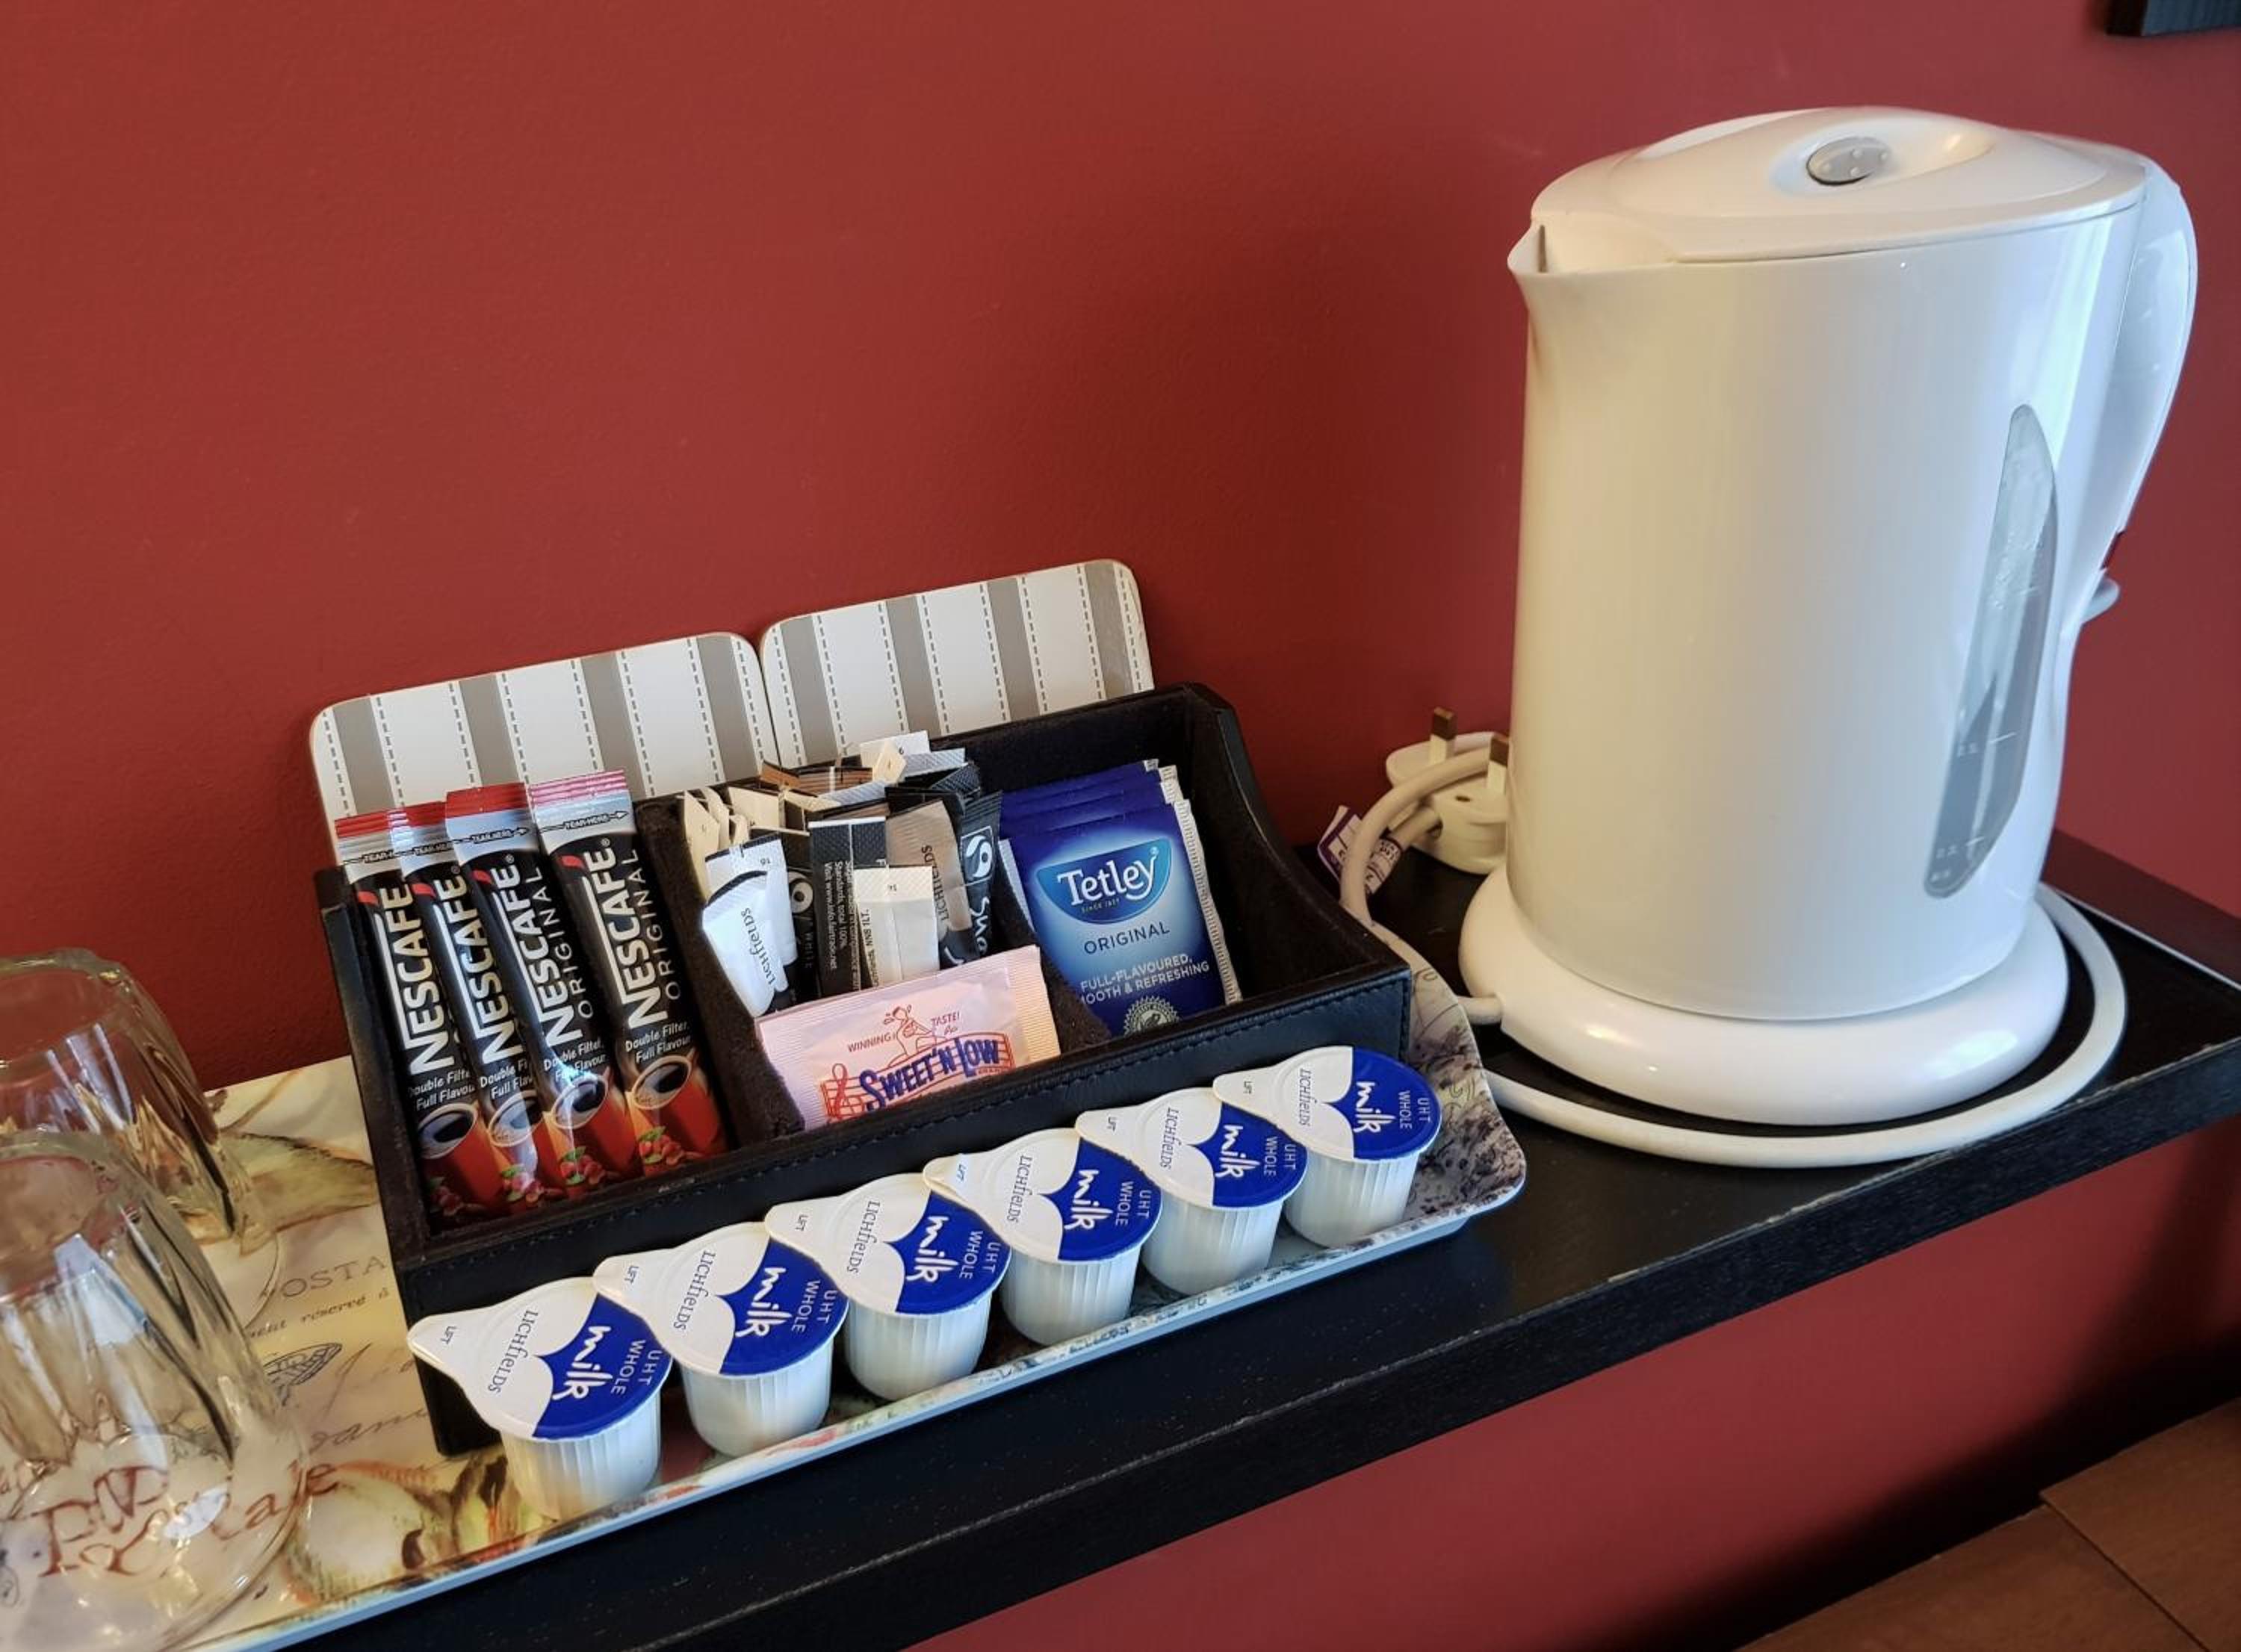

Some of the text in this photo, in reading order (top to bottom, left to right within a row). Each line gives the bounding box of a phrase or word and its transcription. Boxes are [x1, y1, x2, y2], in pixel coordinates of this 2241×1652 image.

[1057, 854, 1158, 906] Tetley
[622, 849, 681, 1000] ORIGINAL
[1084, 921, 1171, 955] ORIGINAL
[525, 867, 594, 1019] ORIGINAL
[1082, 984, 1121, 1004] OOTH
[1135, 960, 1210, 991] REFRESHING
[625, 1030, 660, 1052] Double
[636, 1035, 691, 1063] Full Flavour
[480, 1066, 516, 1088] Double
[491, 1081, 510, 1099] Full
[1243, 1081, 1253, 1095] LIFT
[416, 1084, 476, 1111] Full Flavou
[1398, 1090, 1413, 1130] WHOLE
[1417, 1096, 1431, 1124] UHT
[1106, 1116, 1117, 1132] LIFT
[1264, 1136, 1278, 1178] WHOLE
[1284, 1143, 1297, 1171] UHT
[955, 1164, 967, 1182] LIFT
[1115, 1181, 1135, 1226] WHOLE
[1136, 1189, 1153, 1220] UHT
[796, 1214, 809, 1232] LIFT
[958, 1230, 984, 1279] WHOLE
[982, 1242, 1002, 1273] UHT
[624, 1265, 640, 1285] LIFT
[791, 1279, 822, 1334] WHOLE
[816, 1289, 838, 1325] UHT
[440, 1325, 457, 1345] LIFT
[610, 1338, 646, 1396] WHOLE
[637, 1349, 663, 1386] UHT
